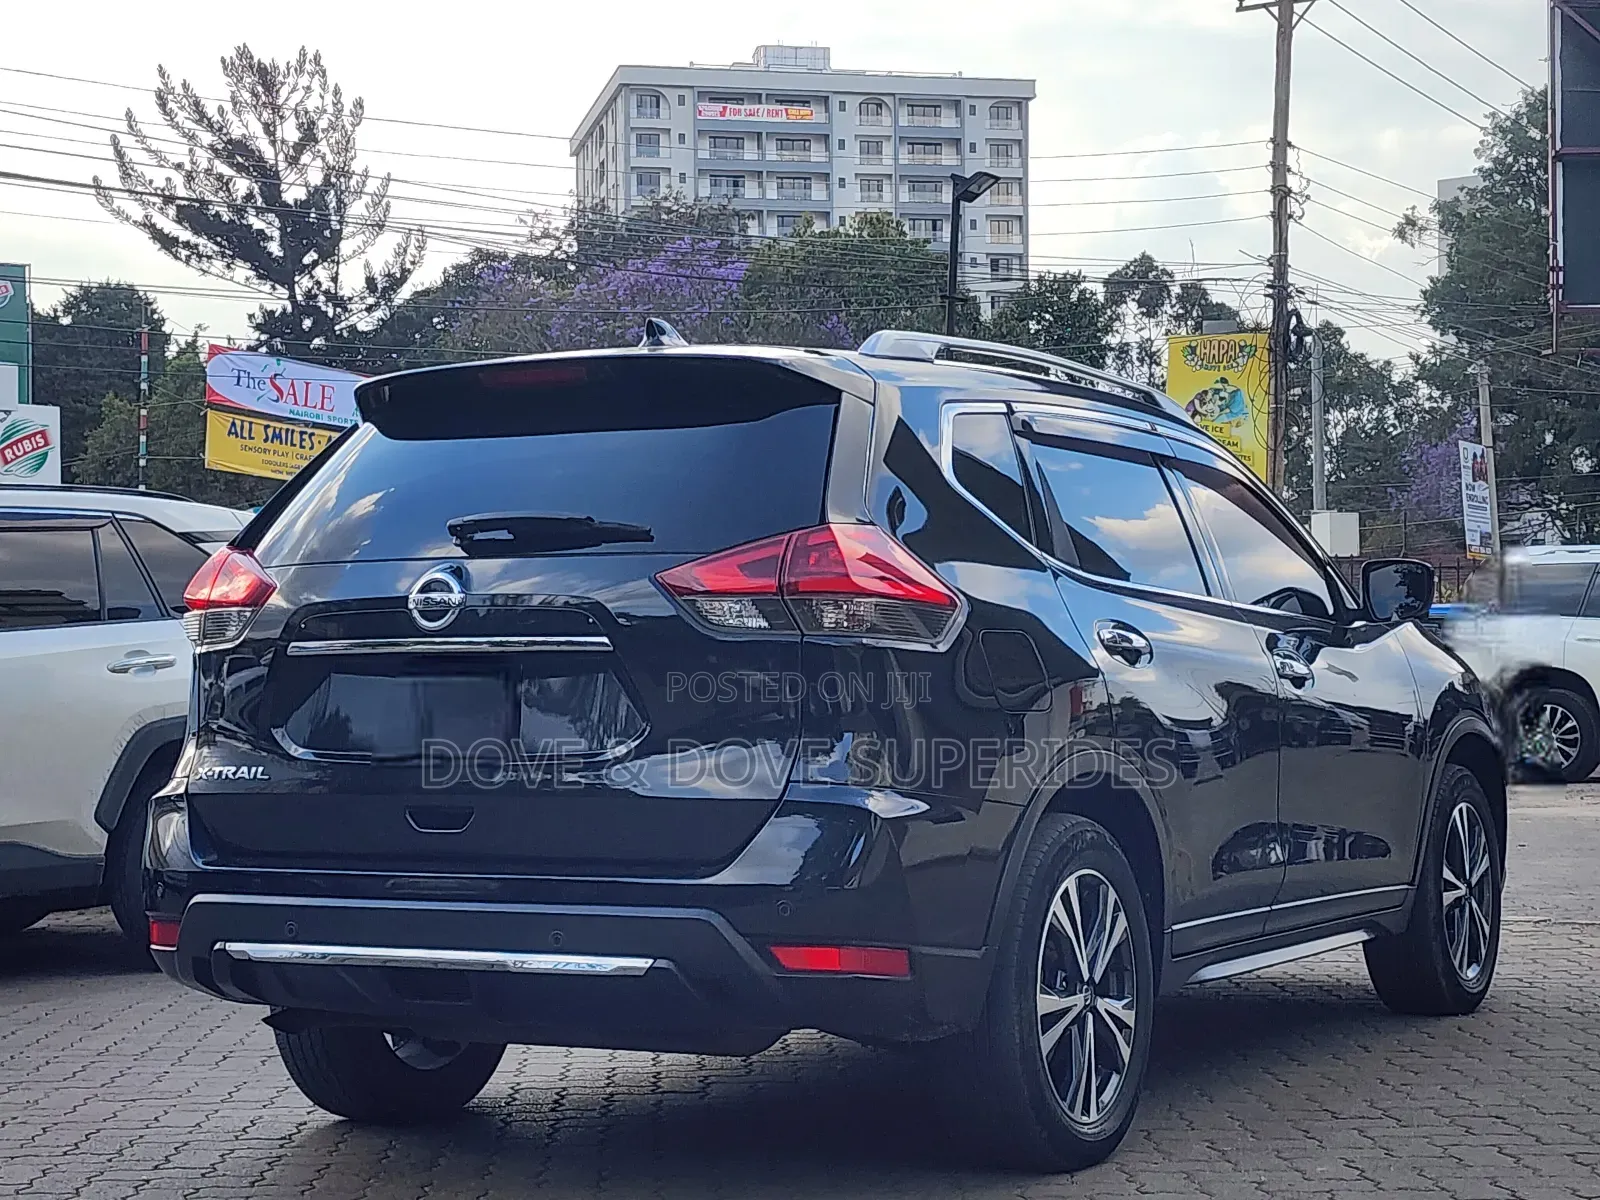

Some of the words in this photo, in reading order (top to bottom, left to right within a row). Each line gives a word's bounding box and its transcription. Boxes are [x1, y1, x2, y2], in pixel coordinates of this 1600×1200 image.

[729, 108, 743, 117] FOR
[743, 108, 760, 118] SALE
[766, 108, 784, 119] RENT
[1200, 338, 1237, 364] HAPA
[231, 367, 267, 392] The
[268, 372, 336, 412] SALE
[288, 408, 324, 421] NAIROBI
[227, 419, 255, 441] ALL
[262, 424, 316, 451] SMILES
[4, 433, 45, 462] RUBIS
[239, 443, 272, 456] SENSORY
[272, 449, 290, 459] PLAY
[411, 595, 460, 608] NISSAN
[195, 765, 270, 780] X-TRAIL
